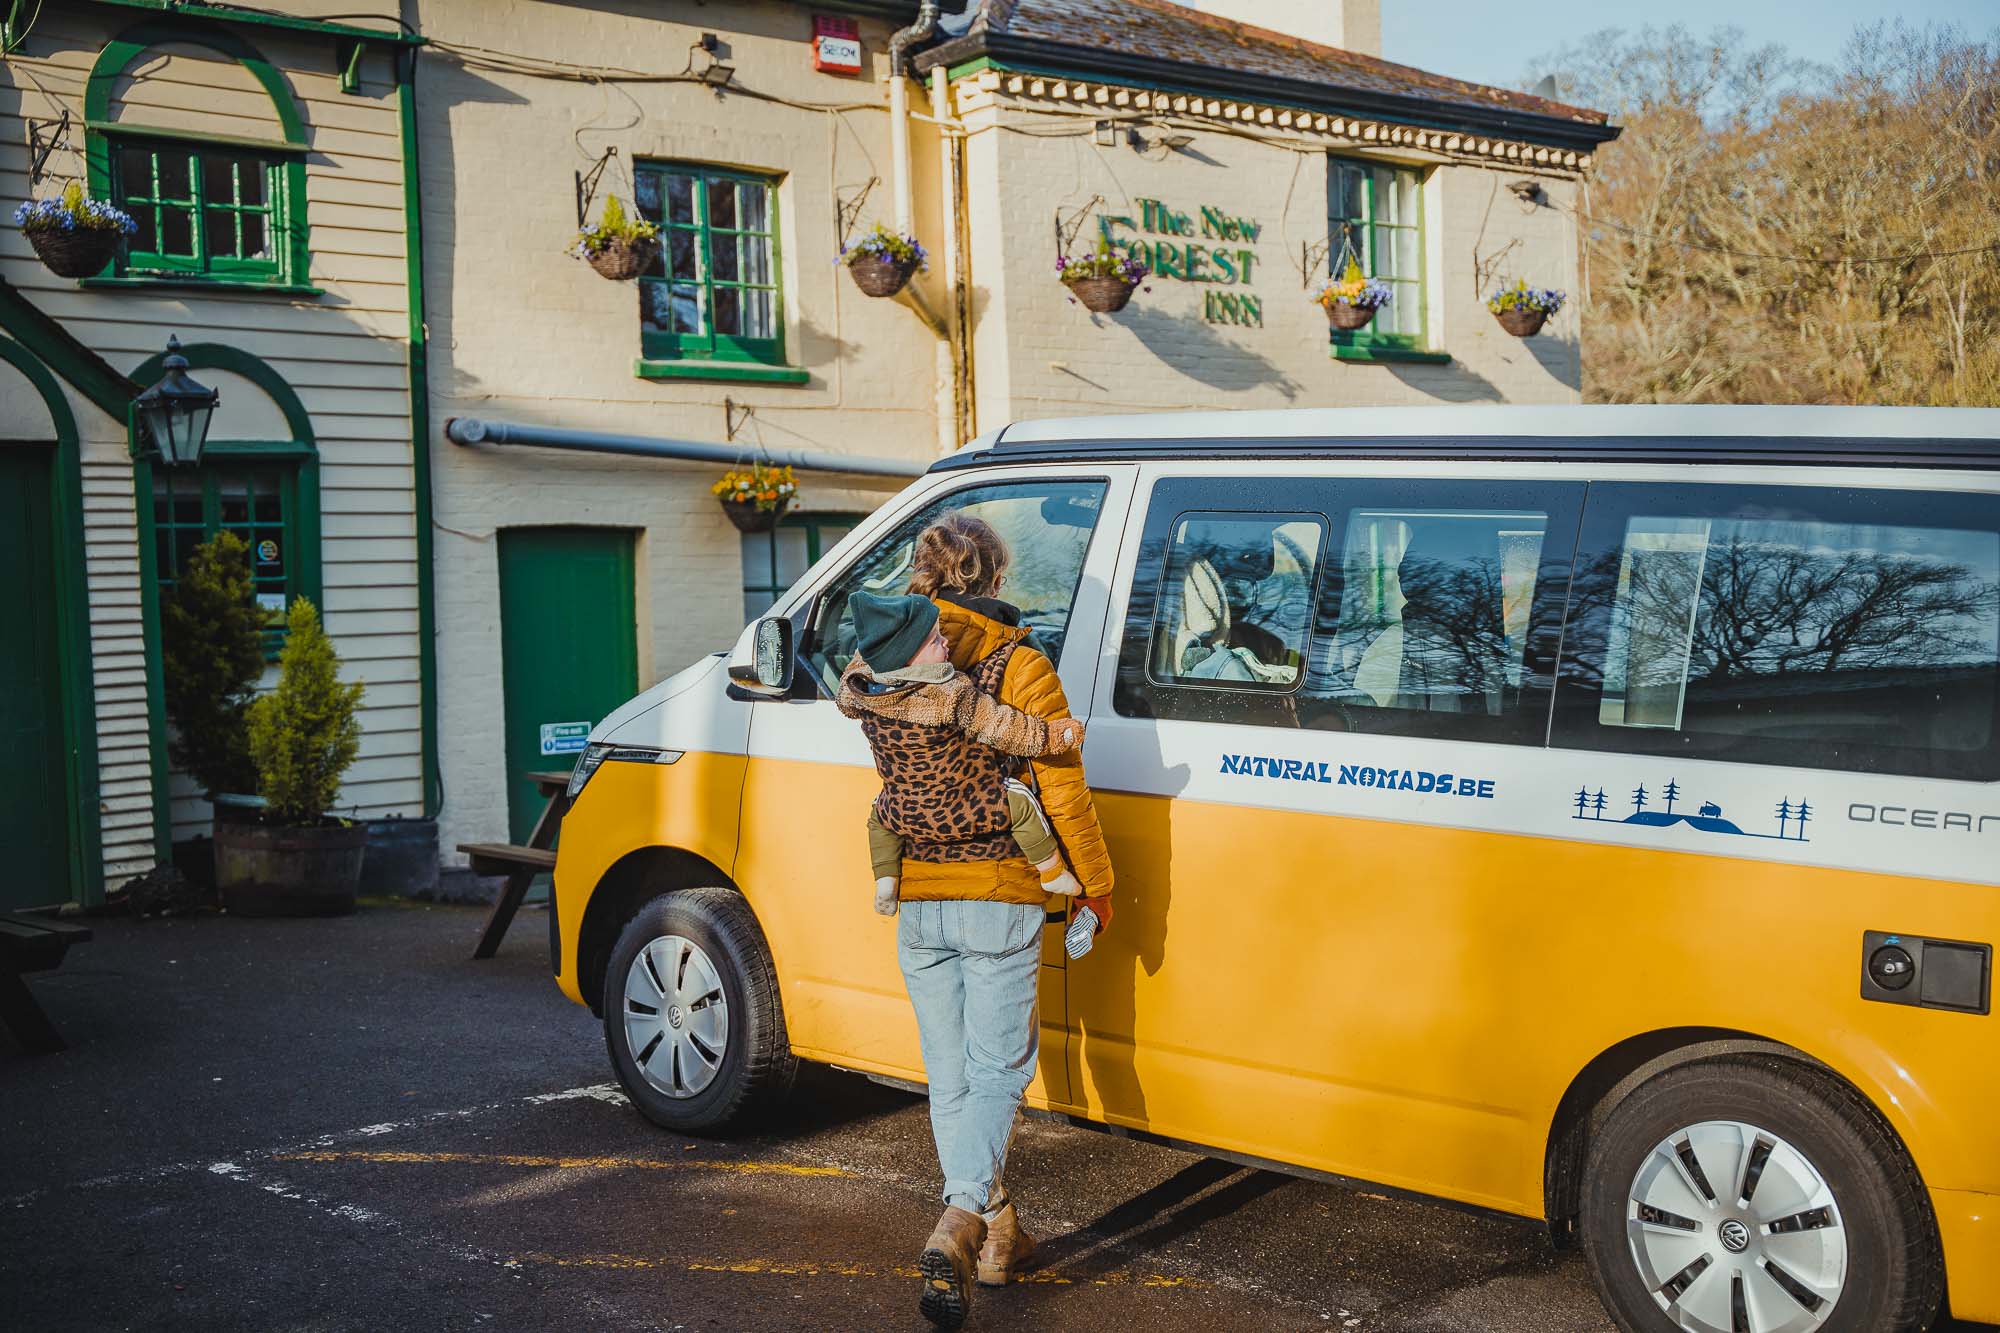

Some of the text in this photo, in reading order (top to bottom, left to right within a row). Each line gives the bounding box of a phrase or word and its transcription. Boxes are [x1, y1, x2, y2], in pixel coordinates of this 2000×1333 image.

[1135, 198, 1262, 244] The New
[1204, 290, 1264, 328] INN
[1220, 754, 1496, 799] NATURAL NOMADS.BE
